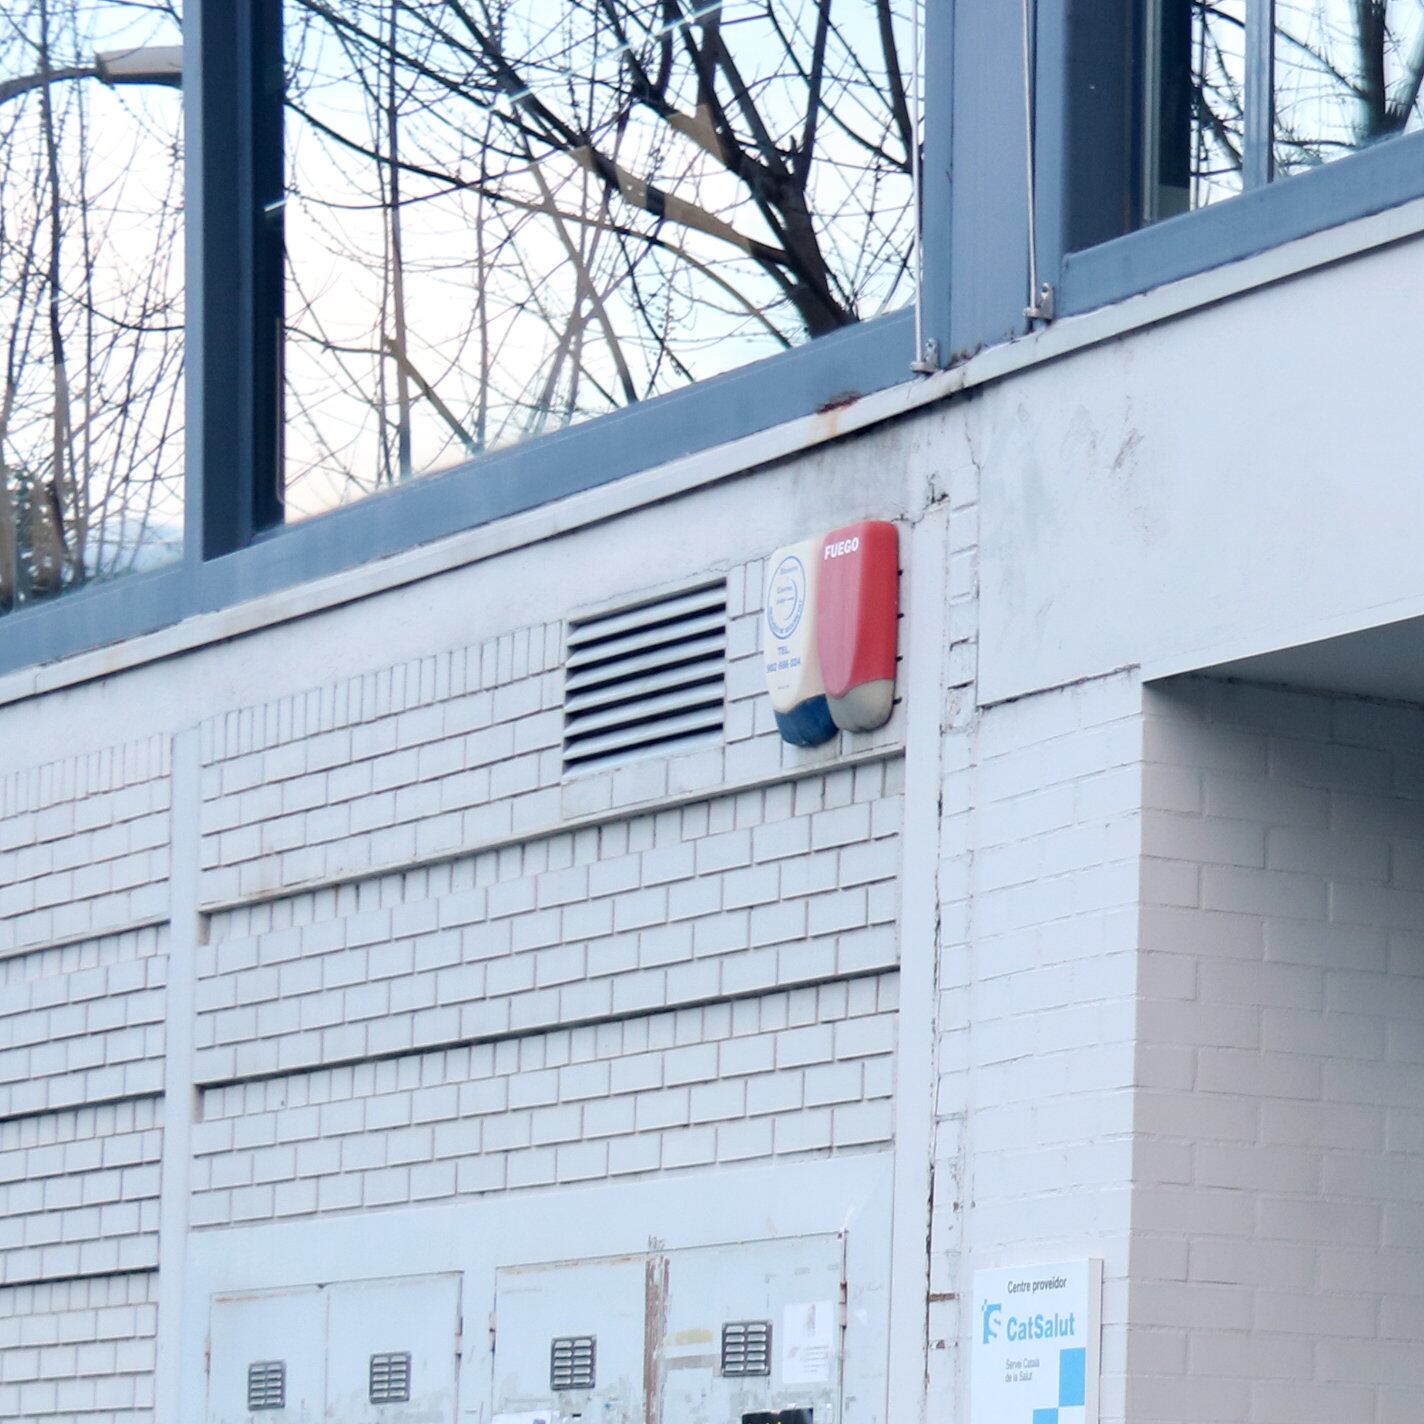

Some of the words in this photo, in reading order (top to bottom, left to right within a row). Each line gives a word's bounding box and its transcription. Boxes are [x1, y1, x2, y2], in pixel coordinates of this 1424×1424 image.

[824, 537, 859, 560] FUEGO
[1007, 1279, 1031, 1294] Centre
[1032, 1275, 1067, 1293] proveïdor
[1006, 1312, 1075, 1342] CatSalut
